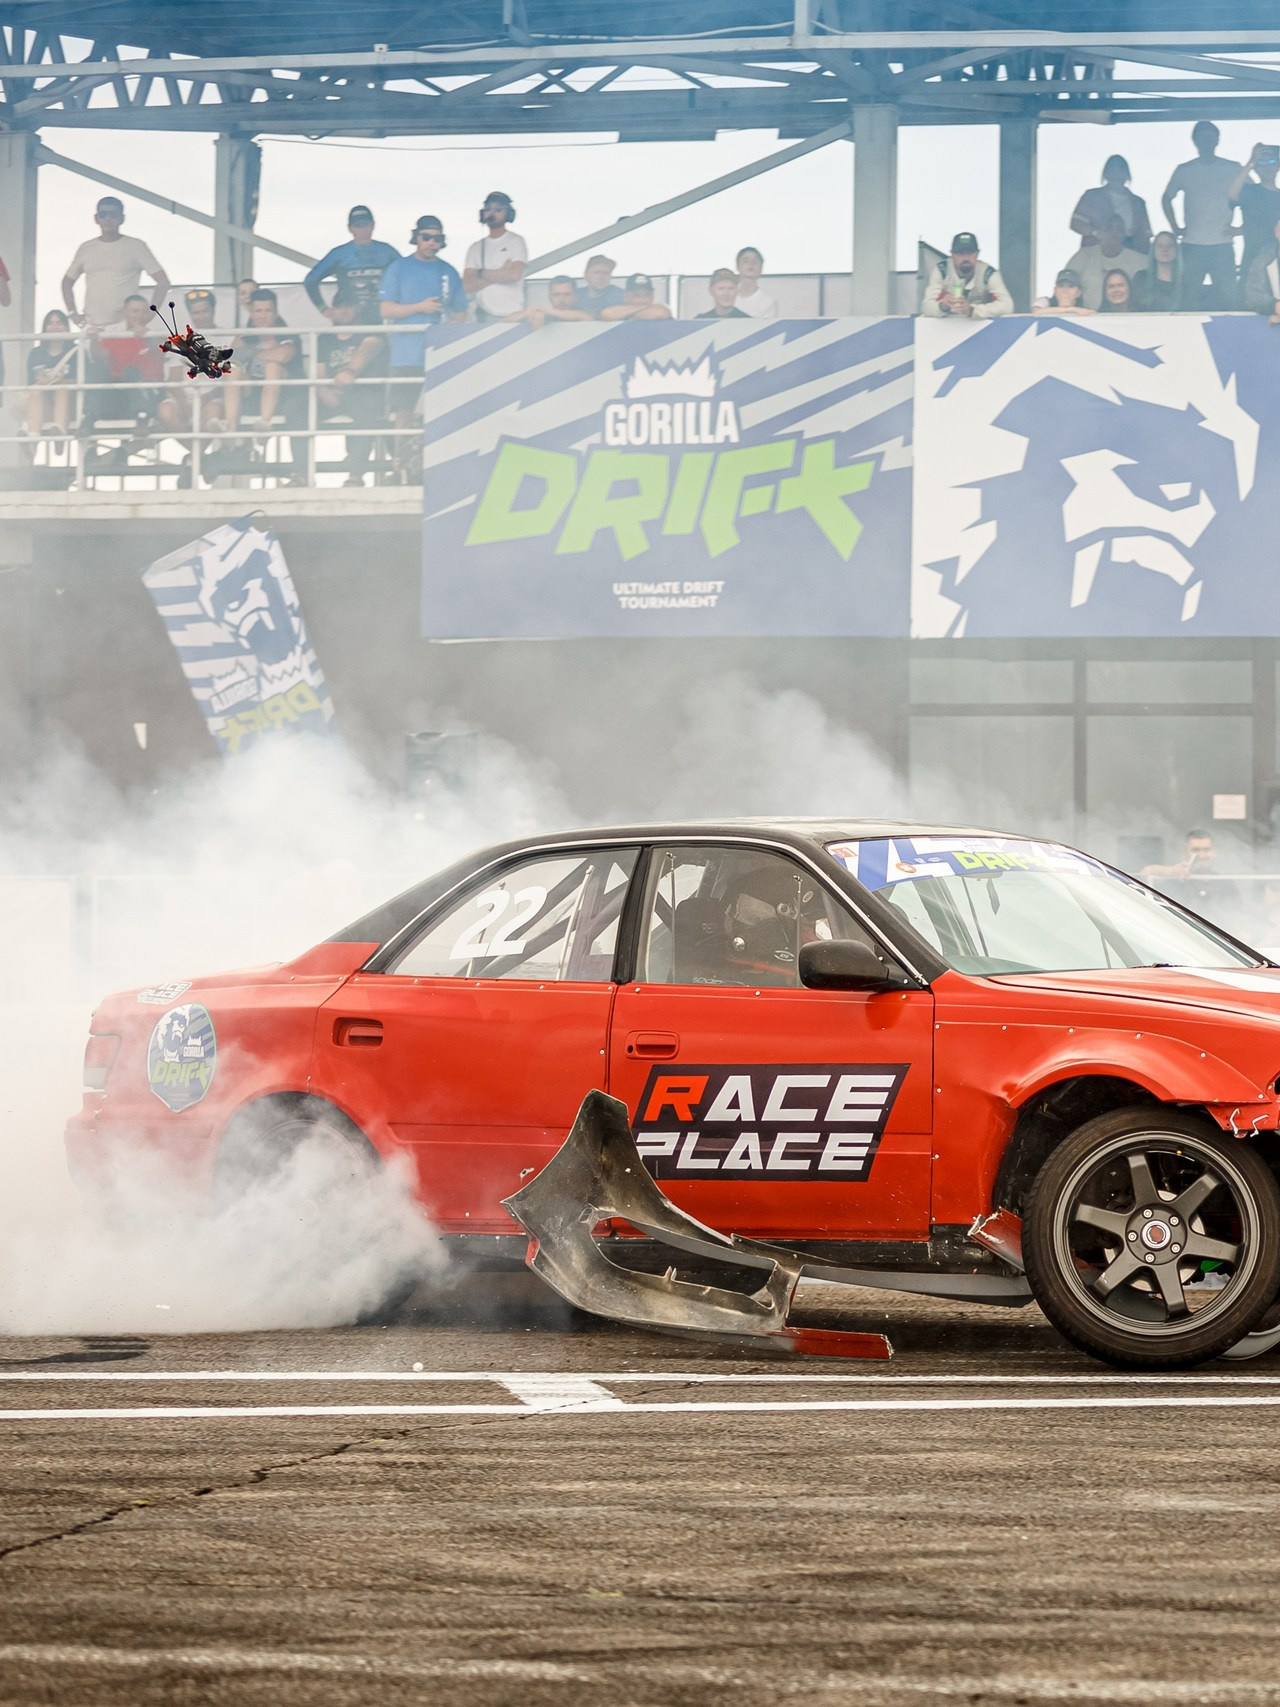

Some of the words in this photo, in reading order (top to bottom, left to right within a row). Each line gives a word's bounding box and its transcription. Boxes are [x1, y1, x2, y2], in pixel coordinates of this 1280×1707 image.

[604, 400, 739, 445] GORILLA
[463, 438, 876, 562] DRIFT
[612, 581, 680, 595] ULTIMATE
[683, 580, 726, 594] DRIFT
[619, 595, 719, 610] TOURNAMENT
[448, 885, 549, 961] 22
[151, 1060, 210, 1090] DRIFT
[642, 1074, 897, 1122] RACE
[636, 1132, 873, 1171] PLACE
